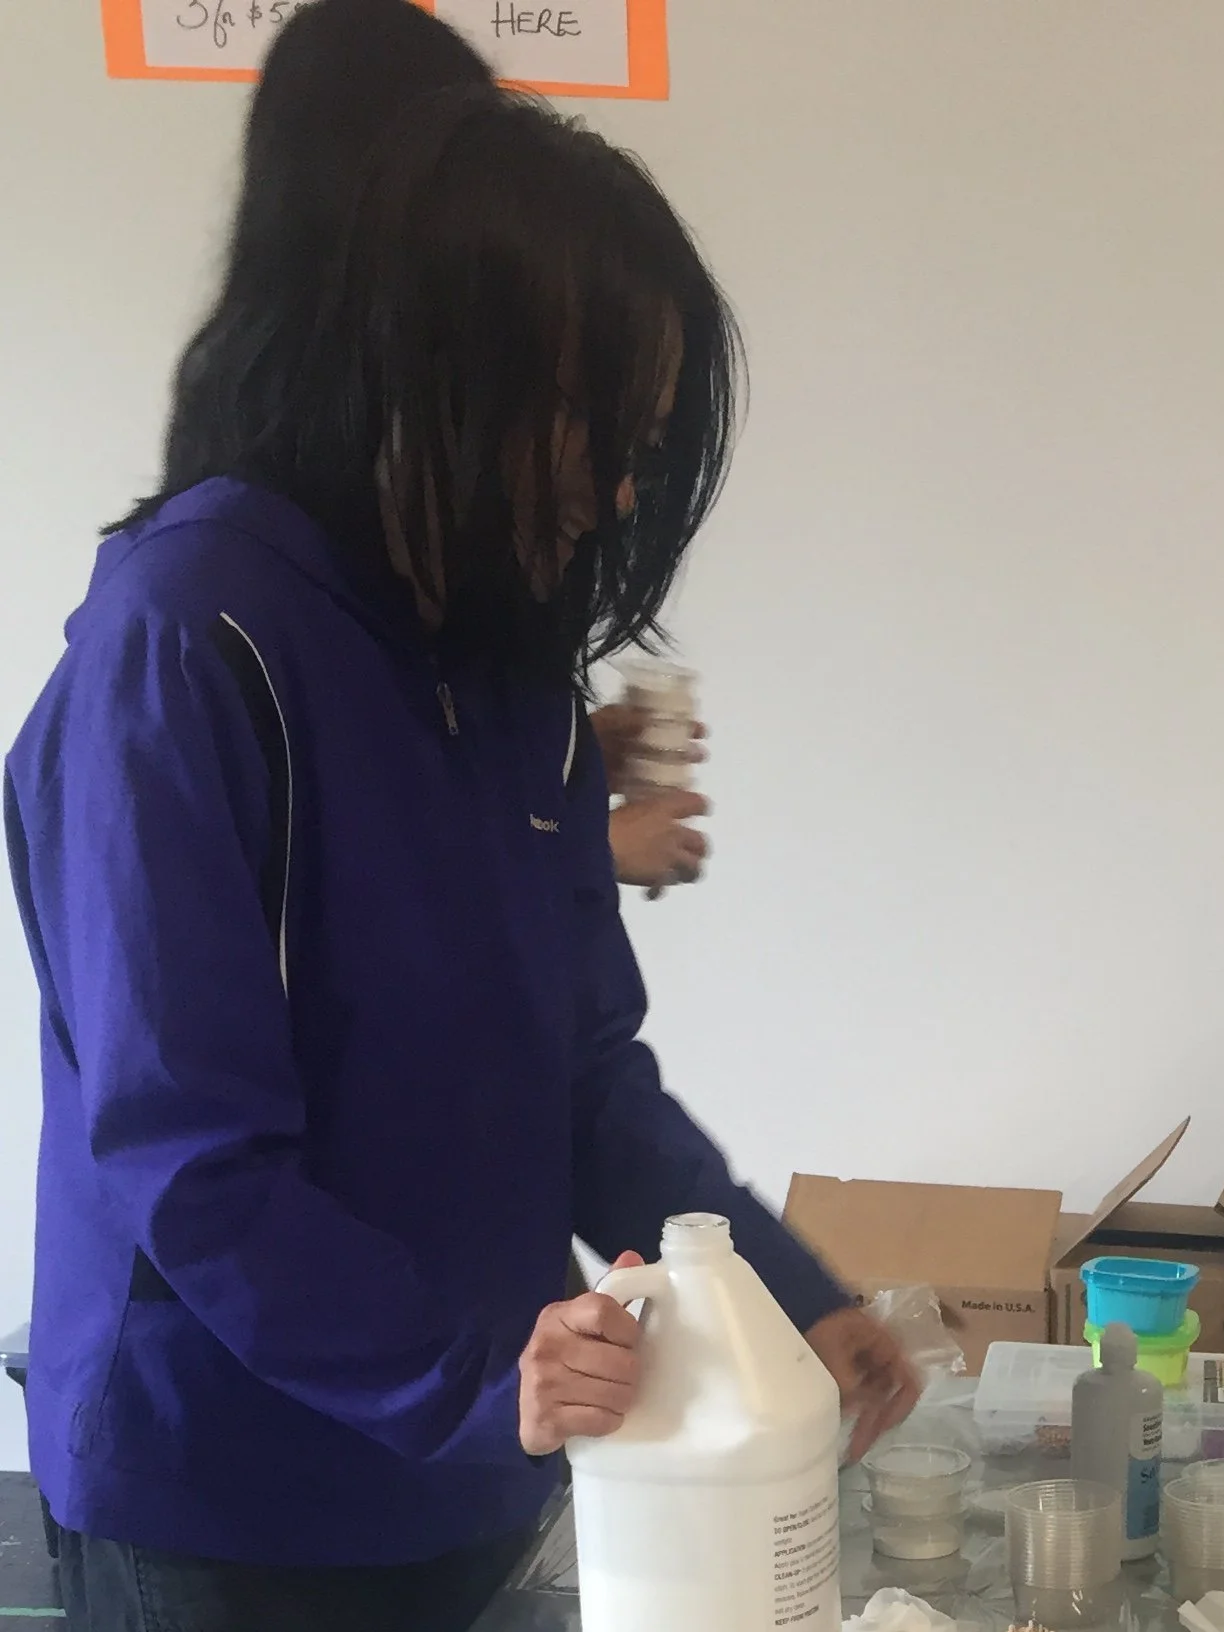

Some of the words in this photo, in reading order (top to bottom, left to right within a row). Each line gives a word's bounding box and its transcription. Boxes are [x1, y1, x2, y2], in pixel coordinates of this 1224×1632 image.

[491, 0, 582, 38] HERE
[961, 1300, 992, 1311] Made
[993, 1301, 1003, 1311] in
